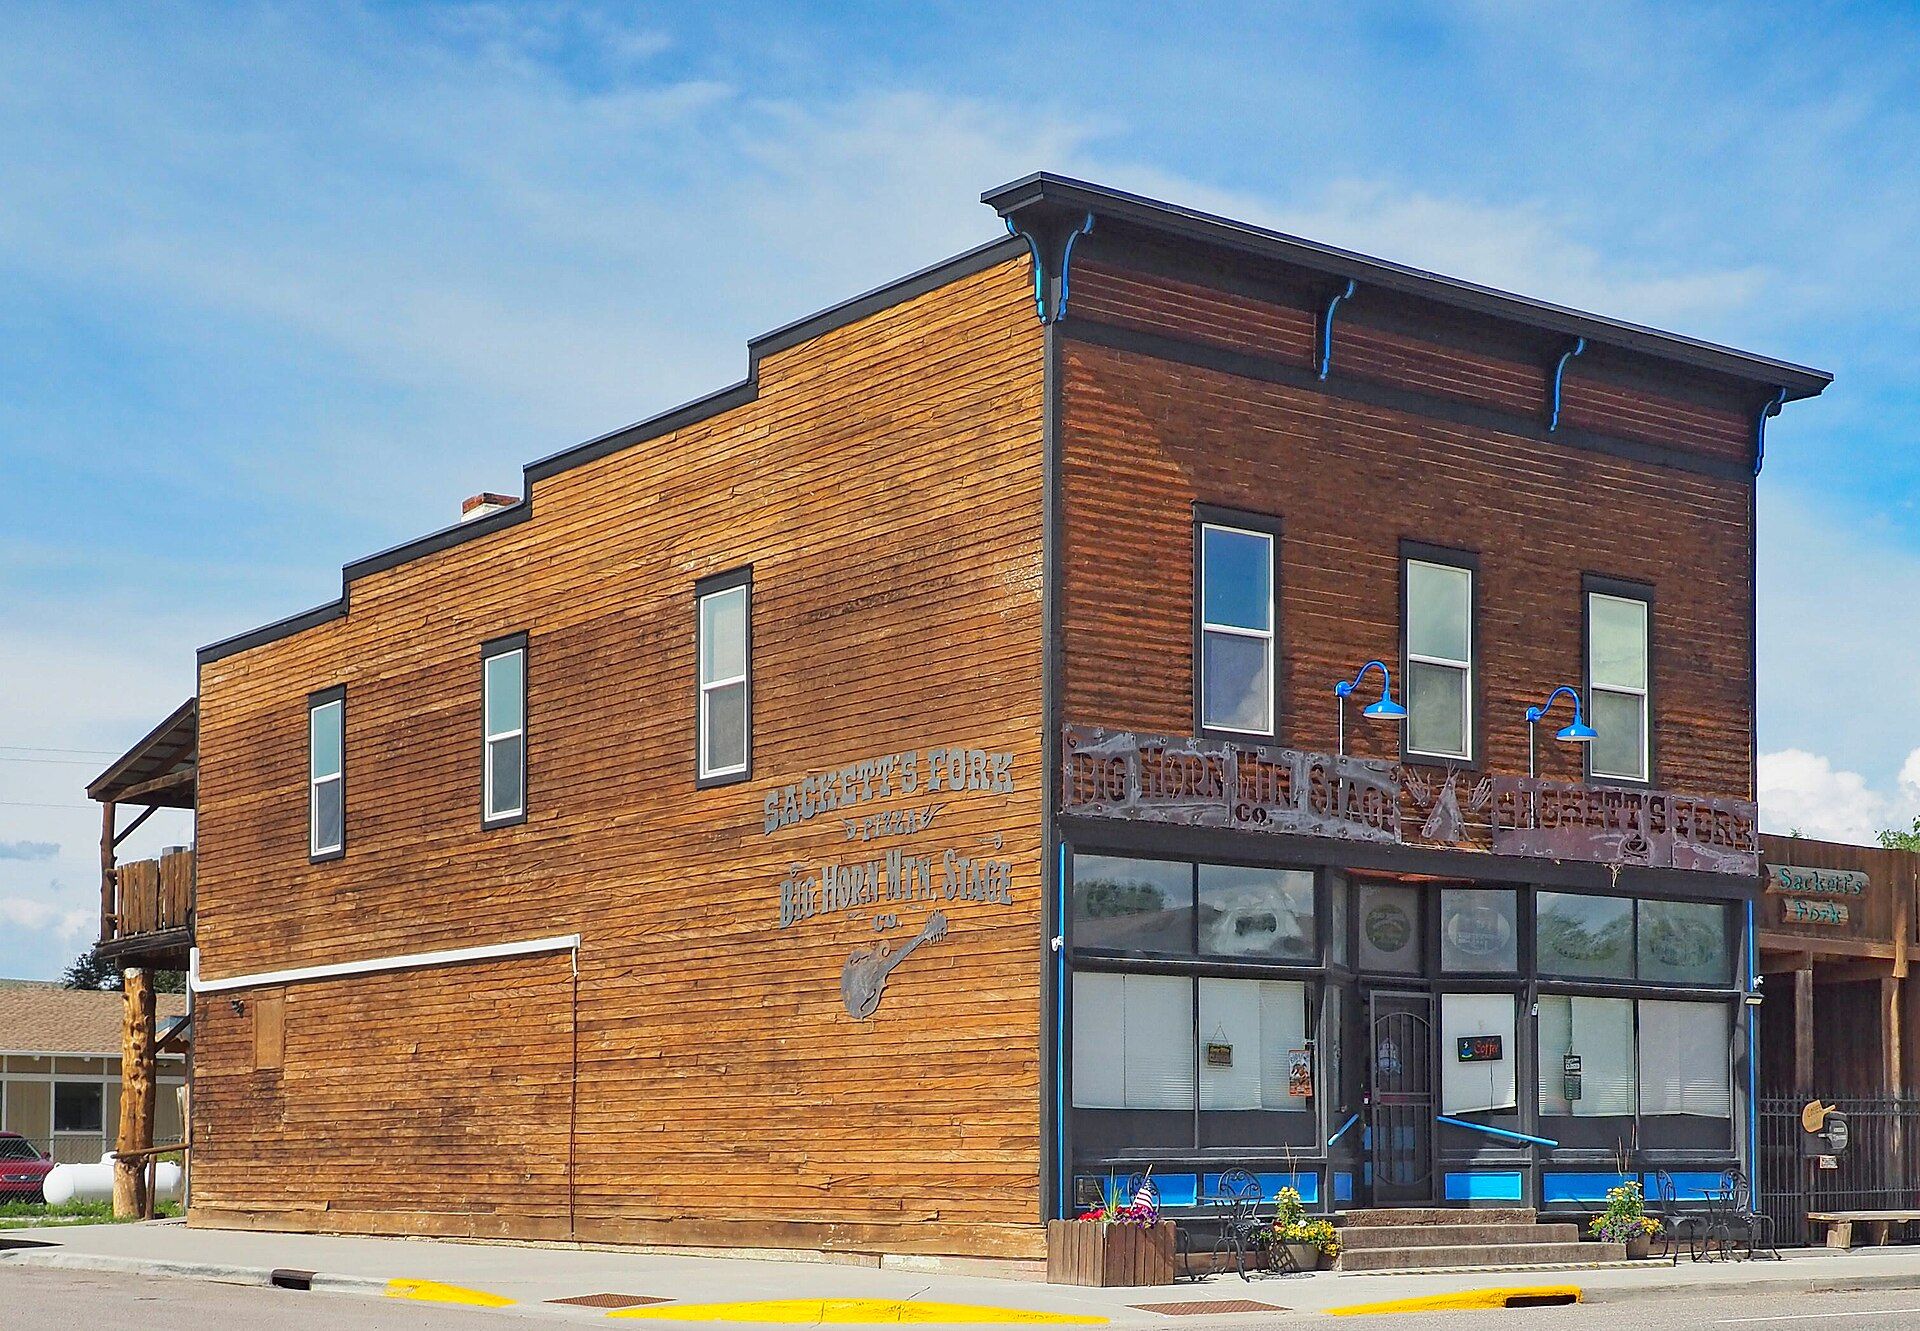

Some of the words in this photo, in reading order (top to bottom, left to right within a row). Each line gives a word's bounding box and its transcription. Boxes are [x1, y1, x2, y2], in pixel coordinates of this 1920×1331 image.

[765, 751, 918, 835] SACKETT'S
[927, 749, 1014, 793] FORK
[1072, 753, 1126, 805] BIG
[1140, 748, 1223, 799] HORN
[1309, 763, 1394, 834] STAGE
[780, 876, 815, 929] BIG
[821, 862, 879, 914] HORN
[942, 849, 1012, 905] STAGE
[1778, 868, 1863, 895] Sackett's
[1794, 900, 1840, 923] Fork
